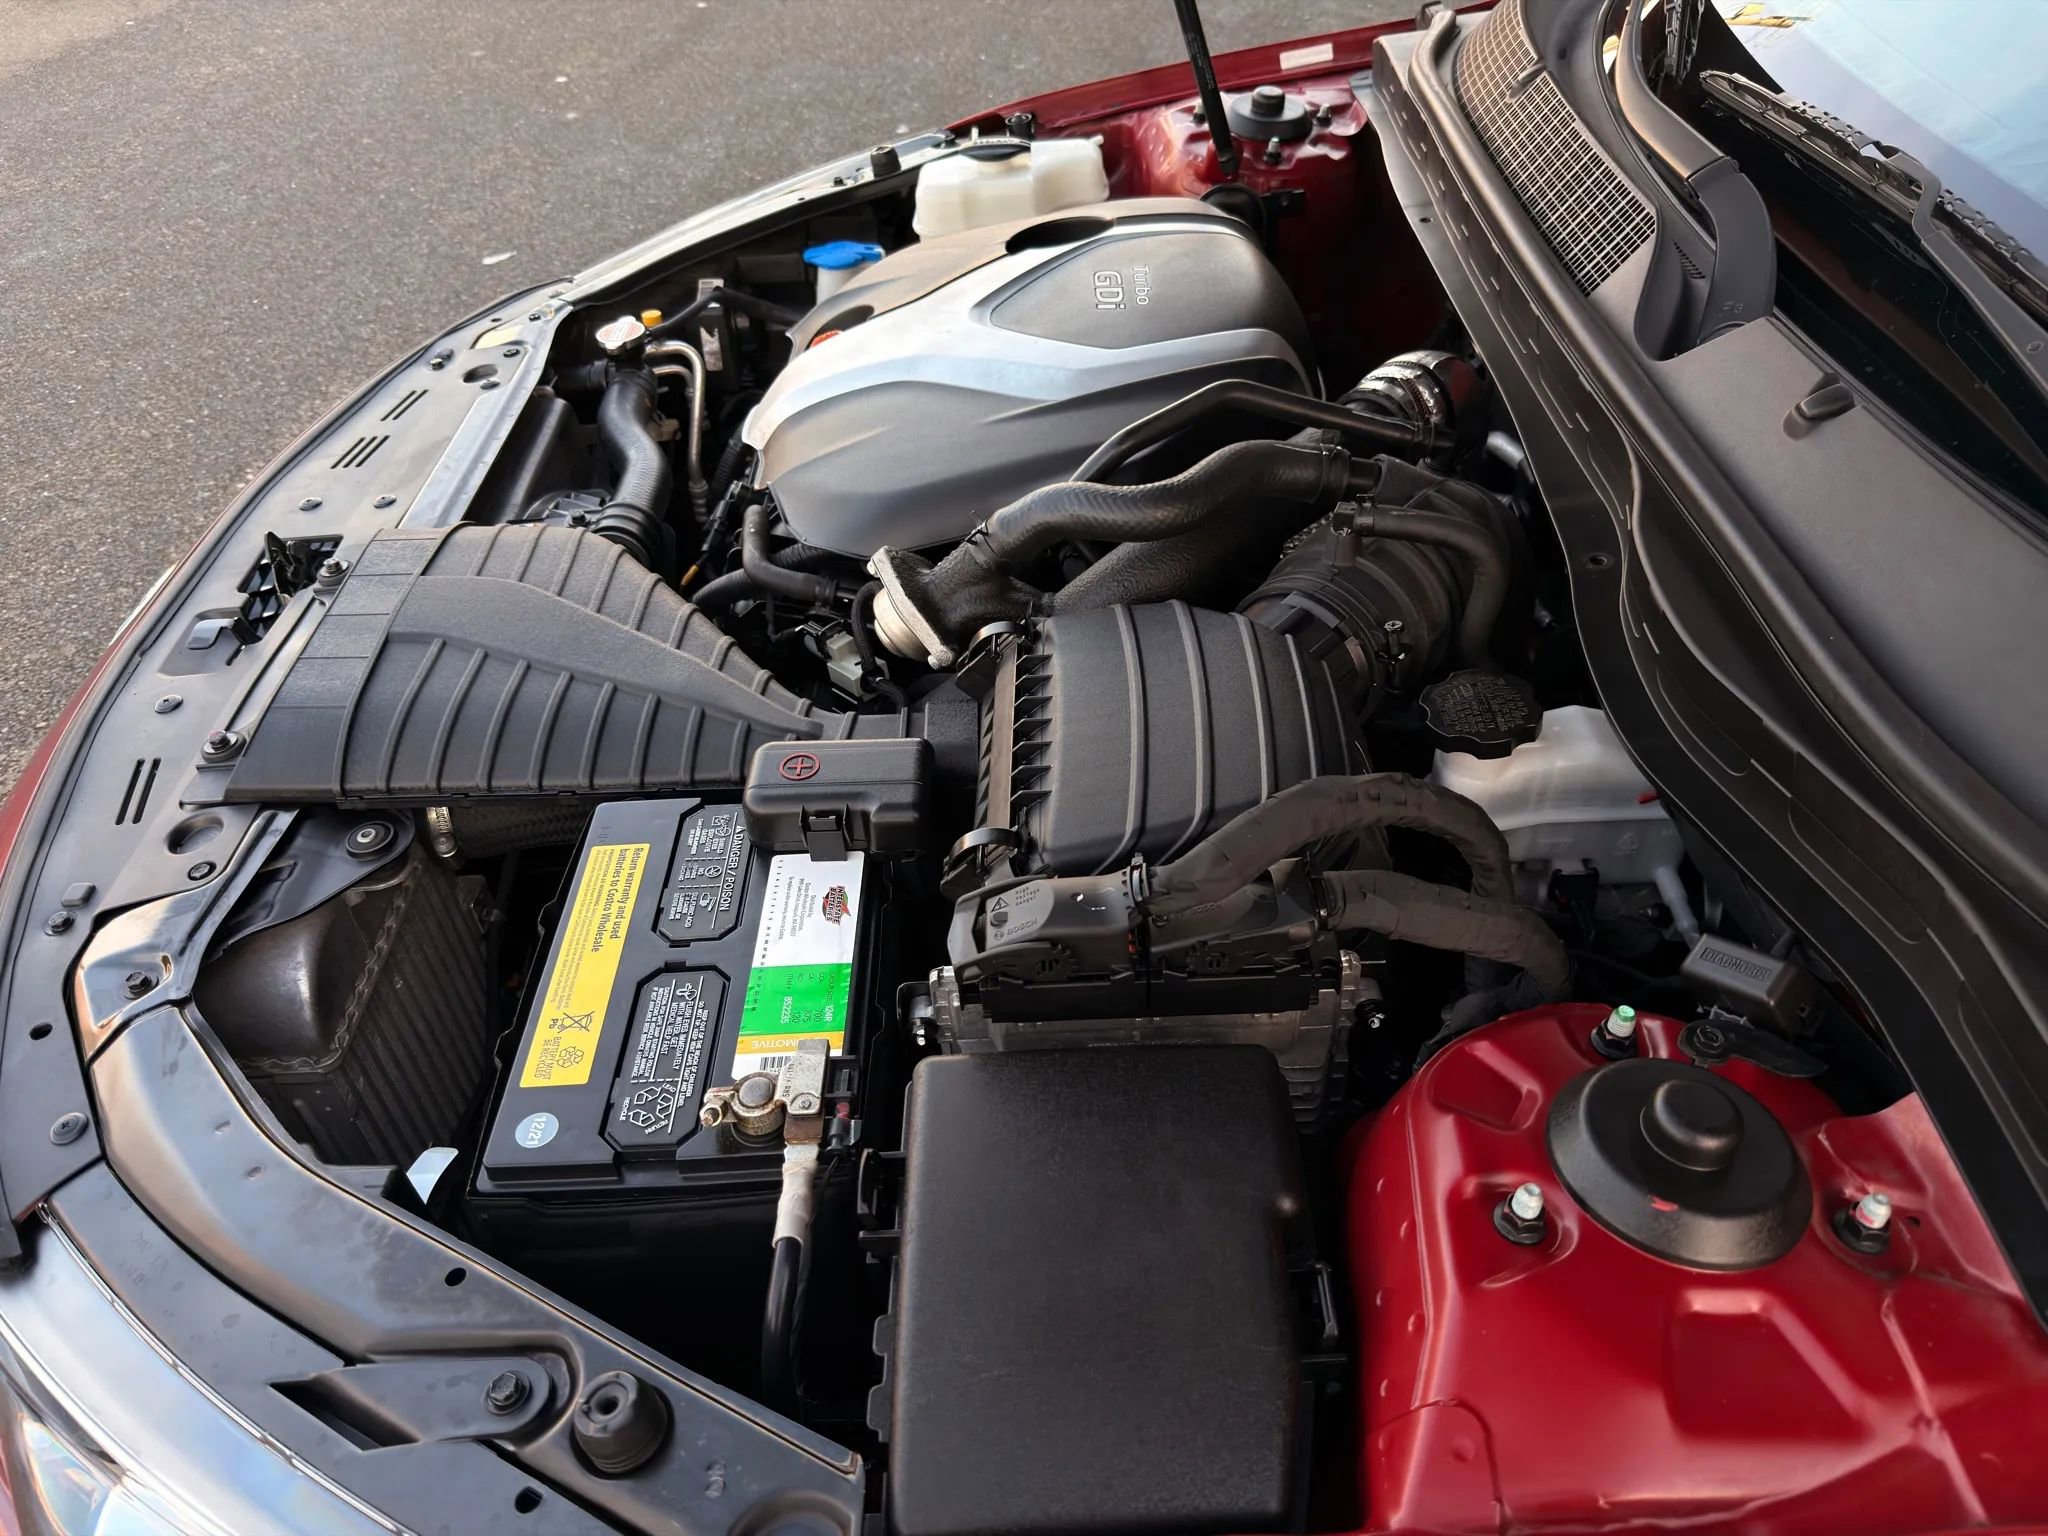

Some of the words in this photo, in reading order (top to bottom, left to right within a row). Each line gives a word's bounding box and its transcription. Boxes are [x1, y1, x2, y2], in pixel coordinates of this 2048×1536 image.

[1093, 270, 1125, 309] GDi
[1133, 264, 1151, 304] Turbo
[628, 847, 644, 870] Return
[728, 834, 743, 868] DANGER
[611, 848, 630, 878] batteries
[619, 871, 637, 903] warranty
[719, 877, 734, 910] POISON
[602, 888, 619, 911] Costco
[615, 905, 628, 917] and
[824, 887, 837, 921] BATTERIES
[832, 885, 845, 924] INTERSTATE
[591, 912, 612, 952] Wholesale
[609, 919, 624, 938] used
[1006, 918, 1038, 936] BOSCH
[666, 1002, 678, 1025] MEDICAL
[677, 1001, 686, 1014] WITH
[683, 1001, 693, 1017] FLUSH
[779, 996, 792, 1024] 852235
[790, 1011, 800, 1023] 120
[801, 1009, 811, 1022] 875
[813, 1009, 822, 1022] 700
[824, 1004, 833, 1022] 124R
[548, 1018, 558, 1029] Pb
[663, 1026, 673, 1039] HELP
[680, 1019, 689, 1032] EYES
[547, 1036, 561, 1061] BATTERY
[659, 1040, 669, 1054] FAST
[669, 1036, 678, 1047] GET
[671, 1033, 686, 1069] IMMEDIATELY
[534, 1047, 549, 1077] RECYCLED
[542, 1063, 554, 1079] MUST
[685, 1073, 695, 1096] CHILDREN
[618, 1096, 630, 1120] RECYCLE
[526, 1114, 547, 1145] 12/21
